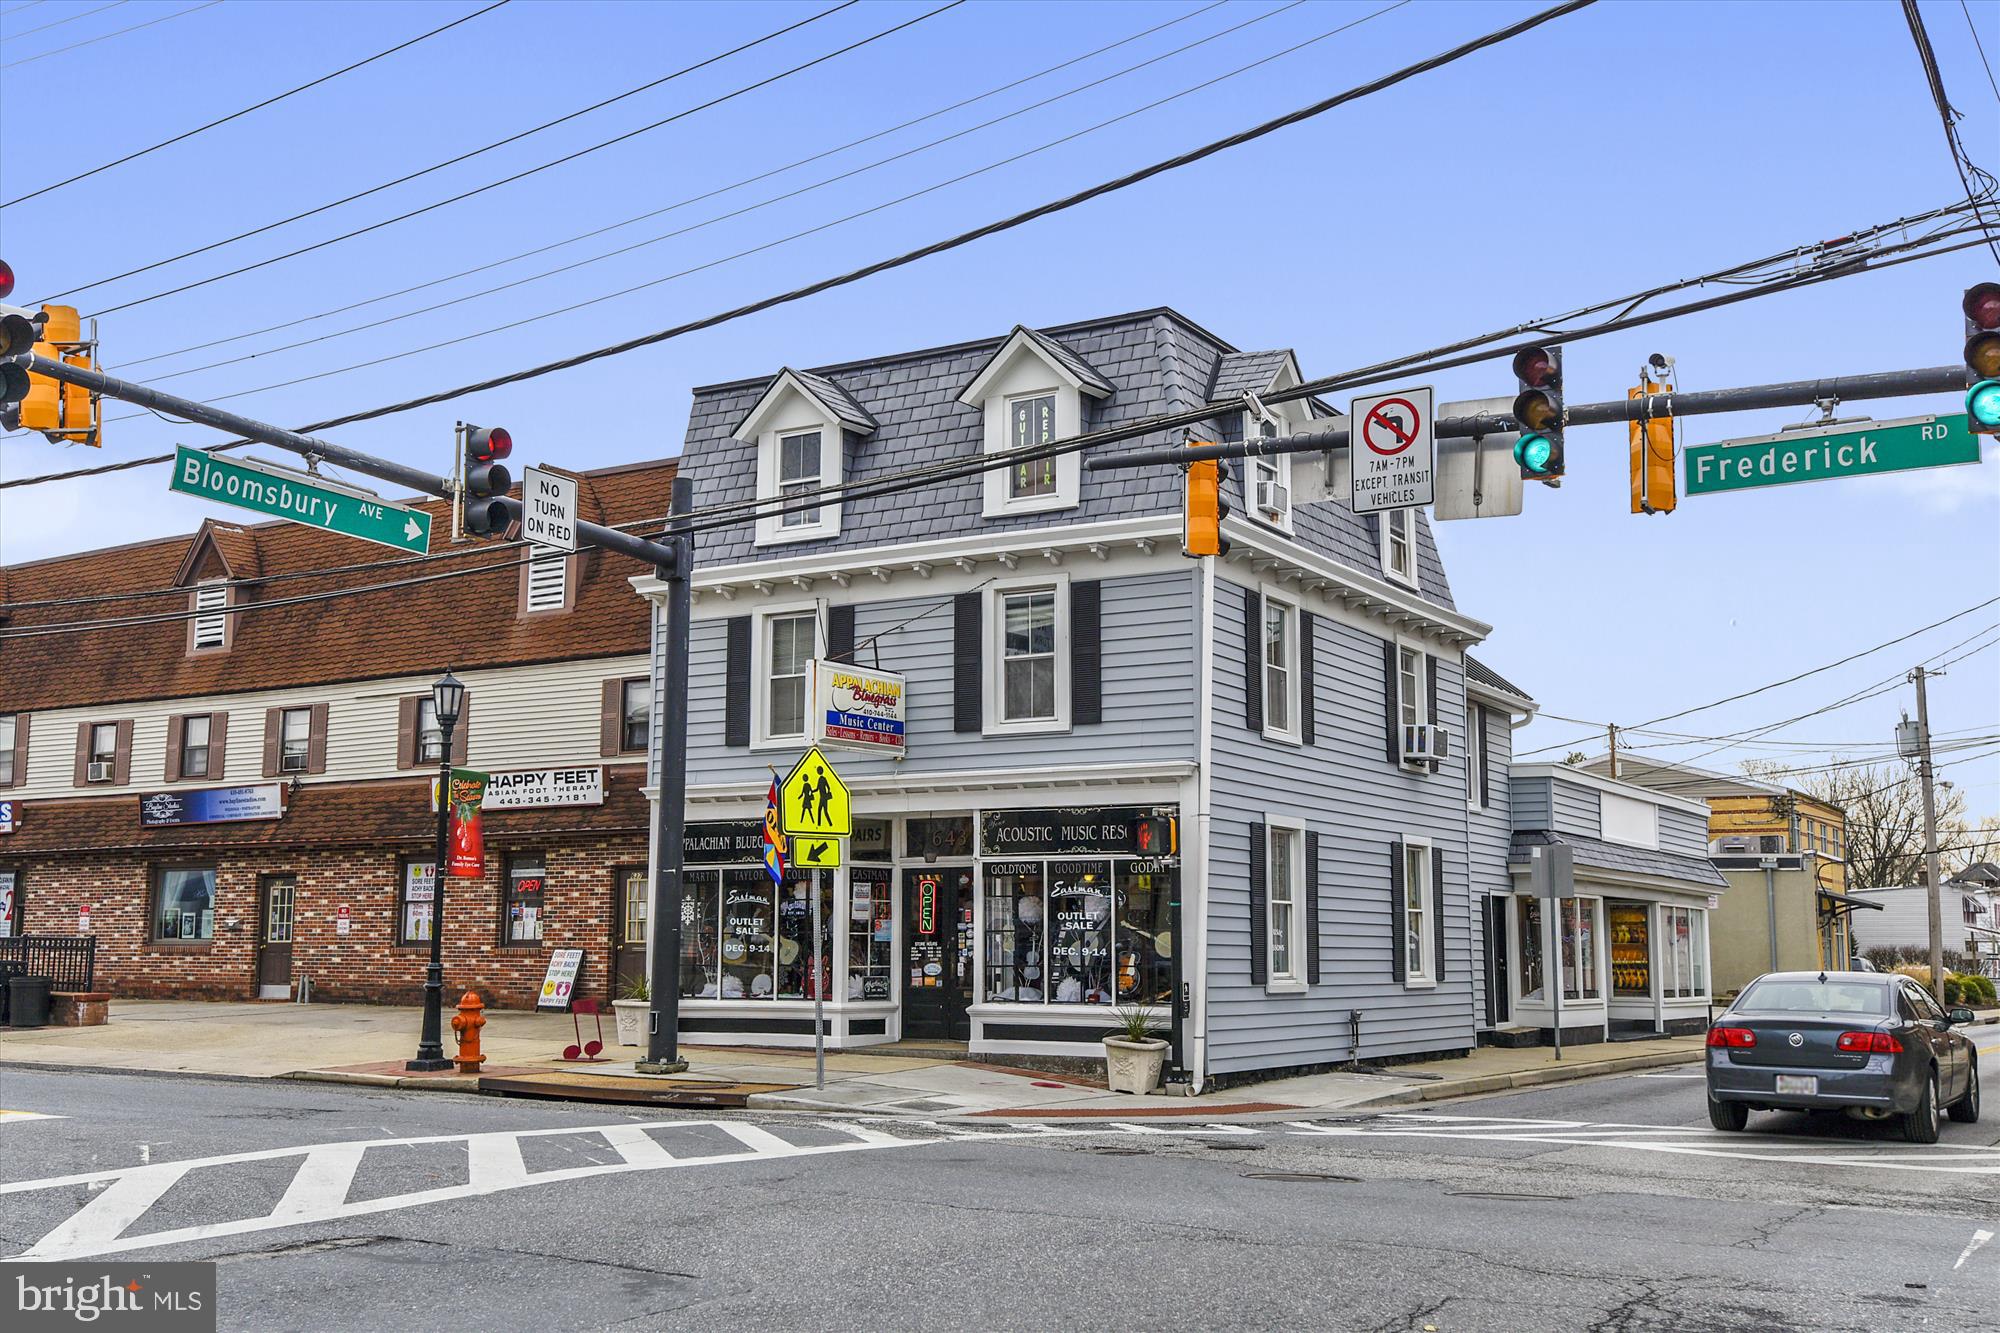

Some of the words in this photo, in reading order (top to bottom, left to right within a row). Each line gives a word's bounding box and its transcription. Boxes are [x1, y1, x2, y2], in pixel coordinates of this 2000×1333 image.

[1019, 409, 1027, 489] GUIAR
[1042, 406, 1051, 485] REPIR
[1696, 436, 1878, 484] Frederick
[1921, 423, 1949, 441] RD
[540, 480, 560, 498] NO
[1354, 478, 1388, 492] EXCEPT
[1392, 469, 1430, 487] TRANSIT
[182, 457, 338, 526] Bloomsbury
[358, 502, 384, 520] AVE
[1370, 488, 1416, 506] VEHICLES
[534, 498, 565, 520] TURN
[527, 517, 544, 534] ON
[548, 522, 571, 541] RED
[831, 673, 901, 698] APPALACHIAN
[851, 685, 897, 708] Bluegrass
[839, 713, 864, 729] Music
[867, 717, 895, 733] Center
[451, 778, 482, 790] Celebrate
[487, 772, 547, 789] HAPPY
[553, 769, 599, 785] FEET
[553, 784, 599, 793] THERAPY
[499, 793, 588, 805] 443-345-7181
[932, 829, 967, 847] 643
[996, 826, 1053, 842] ACOUSTIC
[1061, 825, 1098, 841] MUSIC
[735, 870, 764, 881] TAYLOR
[852, 869, 888, 881] EASTMAN
[990, 863, 1038, 875] GOLDTONE
[1055, 862, 1103, 874] GOODTIME
[689, 872, 718, 882] MARTIN
[517, 879, 541, 893] OPEN
[1050, 880, 1104, 898] Eastman
[726, 889, 770, 905] Eastman
[922, 883, 933, 931] OPEN
[729, 917, 765, 927] OUTLET
[1056, 911, 1099, 922] OUTLET
[735, 926, 760, 936] SALE
[1065, 921, 1095, 931] SALE
[725, 944, 748, 953] DEC.
[749, 944, 770, 953] 9-14
[1052, 946, 1080, 957] DEC.
[1081, 947, 1108, 957] 9-14
